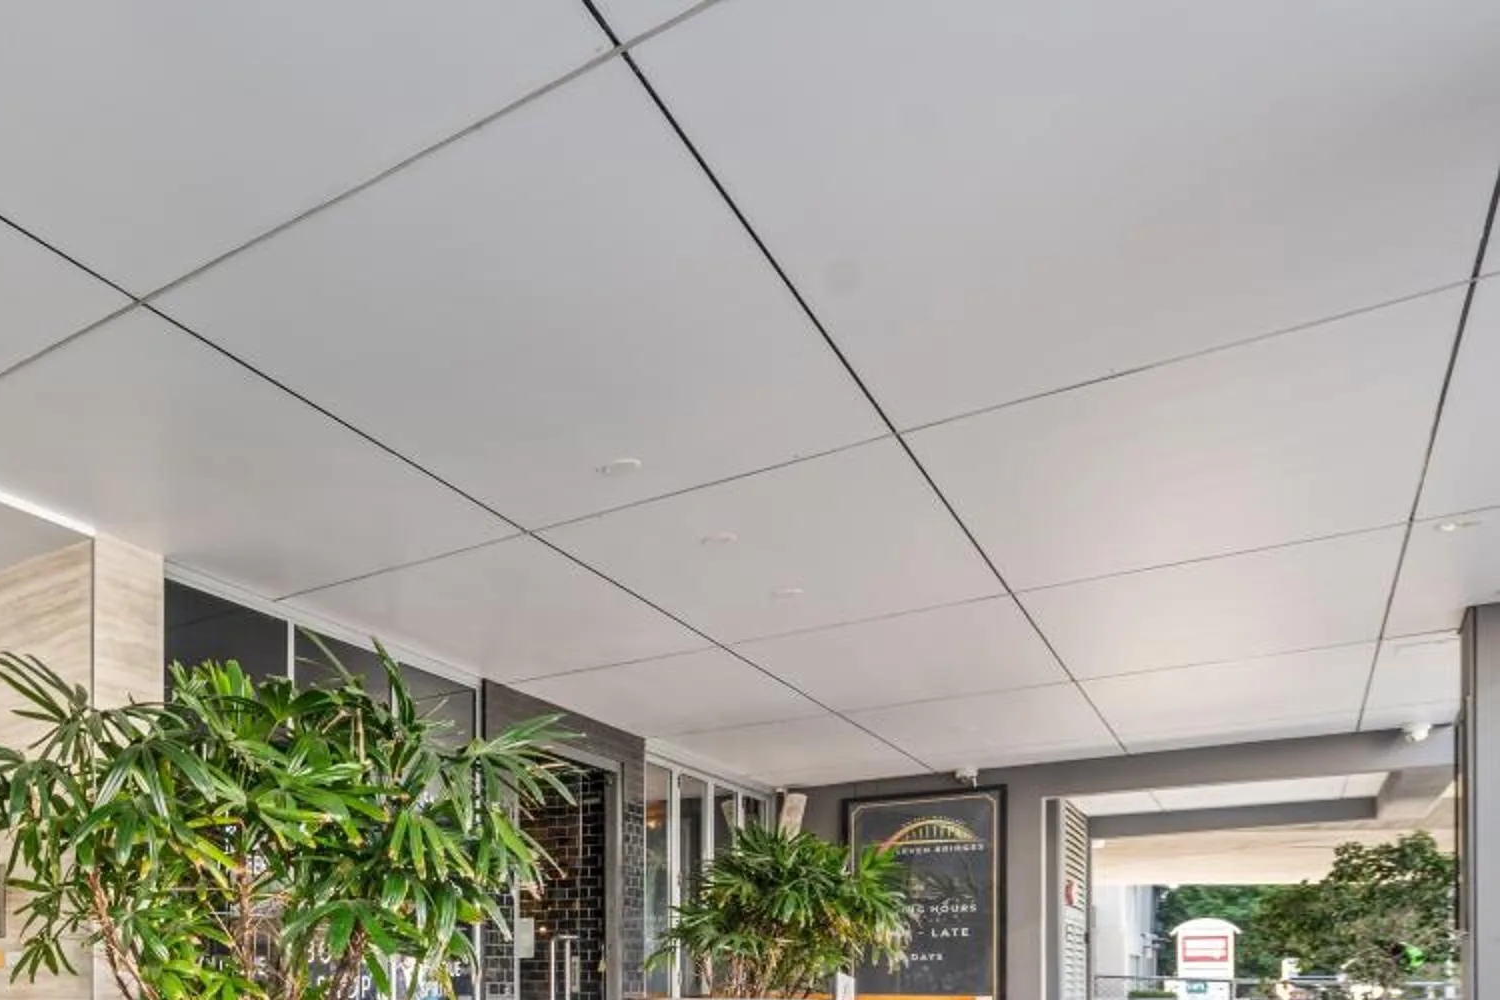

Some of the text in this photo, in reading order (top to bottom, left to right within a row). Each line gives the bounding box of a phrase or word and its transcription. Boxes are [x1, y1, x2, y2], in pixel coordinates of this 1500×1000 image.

[930, 903, 977, 913] HOURS
[931, 927, 969, 937] LATE
[911, 952, 943, 961] DAYS
